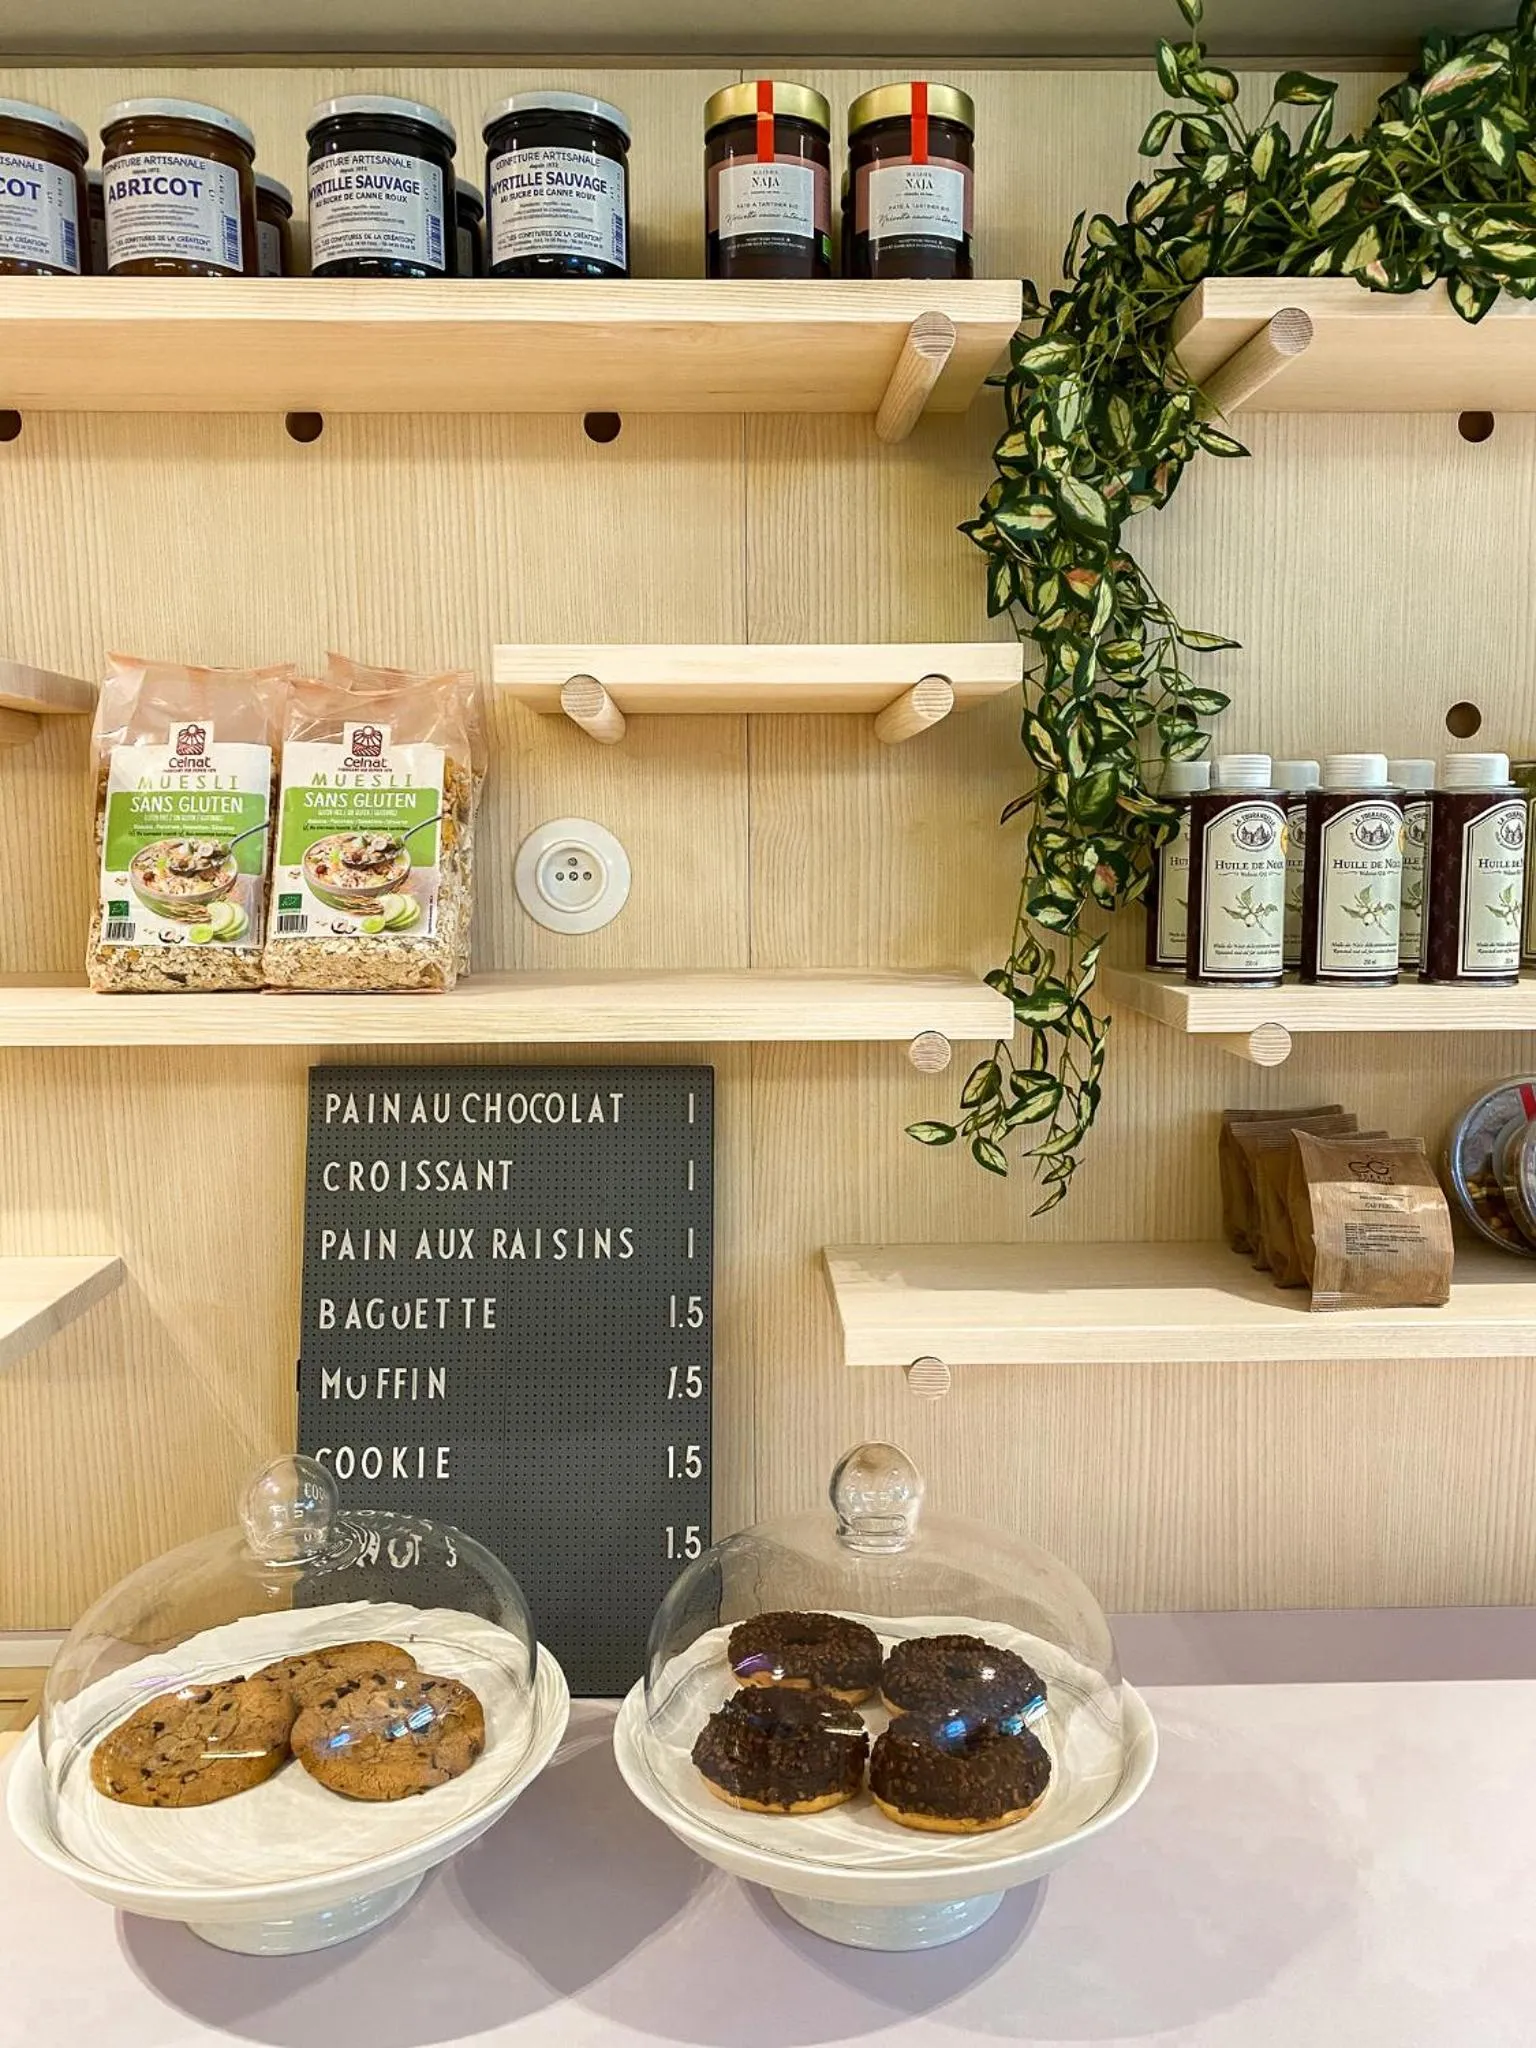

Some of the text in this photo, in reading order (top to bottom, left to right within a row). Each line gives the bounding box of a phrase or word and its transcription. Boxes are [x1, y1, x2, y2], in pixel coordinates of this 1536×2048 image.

[144, 154, 206, 171] ARTISANALE
[352, 154, 412, 170] ARTISANALE
[496, 151, 601, 170] CONFITURE ARTISANALE
[109, 176, 203, 205] ABRICOT
[355, 174, 421, 196] SAUVAGE
[491, 171, 608, 199] MYRTILLE SAUVAGE
[752, 176, 780, 189] NAJA
[905, 178, 933, 191] NAJA
[356, 192, 383, 201] CANNE
[385, 193, 408, 204] ROUX
[509, 190, 532, 201] SUCRE
[534, 189, 543, 197] DE
[545, 188, 573, 197] CANNE
[576, 189, 597, 201] ROUX
[168, 756, 212, 769] Celnat
[343, 756, 387, 770] Celnat
[137, 774, 242, 790] MUESLI
[311, 772, 413, 788] MUESLI
[130, 795, 244, 814] SANS GLUTEN
[303, 791, 417, 809] SANS GLUTEN
[1215, 859, 1249, 870] HUILE
[1333, 858, 1368, 869] HUILE
[1478, 858, 1508, 868] HUILE
[326, 1092, 401, 1124] PAIN
[411, 1092, 451, 1124] AU
[462, 1092, 624, 1124] CHOCOLAT
[322, 1159, 513, 1191] CROISSANT
[321, 1227, 397, 1261] PAIN
[415, 1226, 475, 1261] AUX
[493, 1226, 635, 1261] RAISINS
[319, 1294, 705, 1330] BAGUETTE 1.5
[321, 1365, 703, 1401] MUFFIN 1.5
[315, 1445, 703, 1480] COOKIE 1.5
[665, 1525, 702, 1560] 1.5
